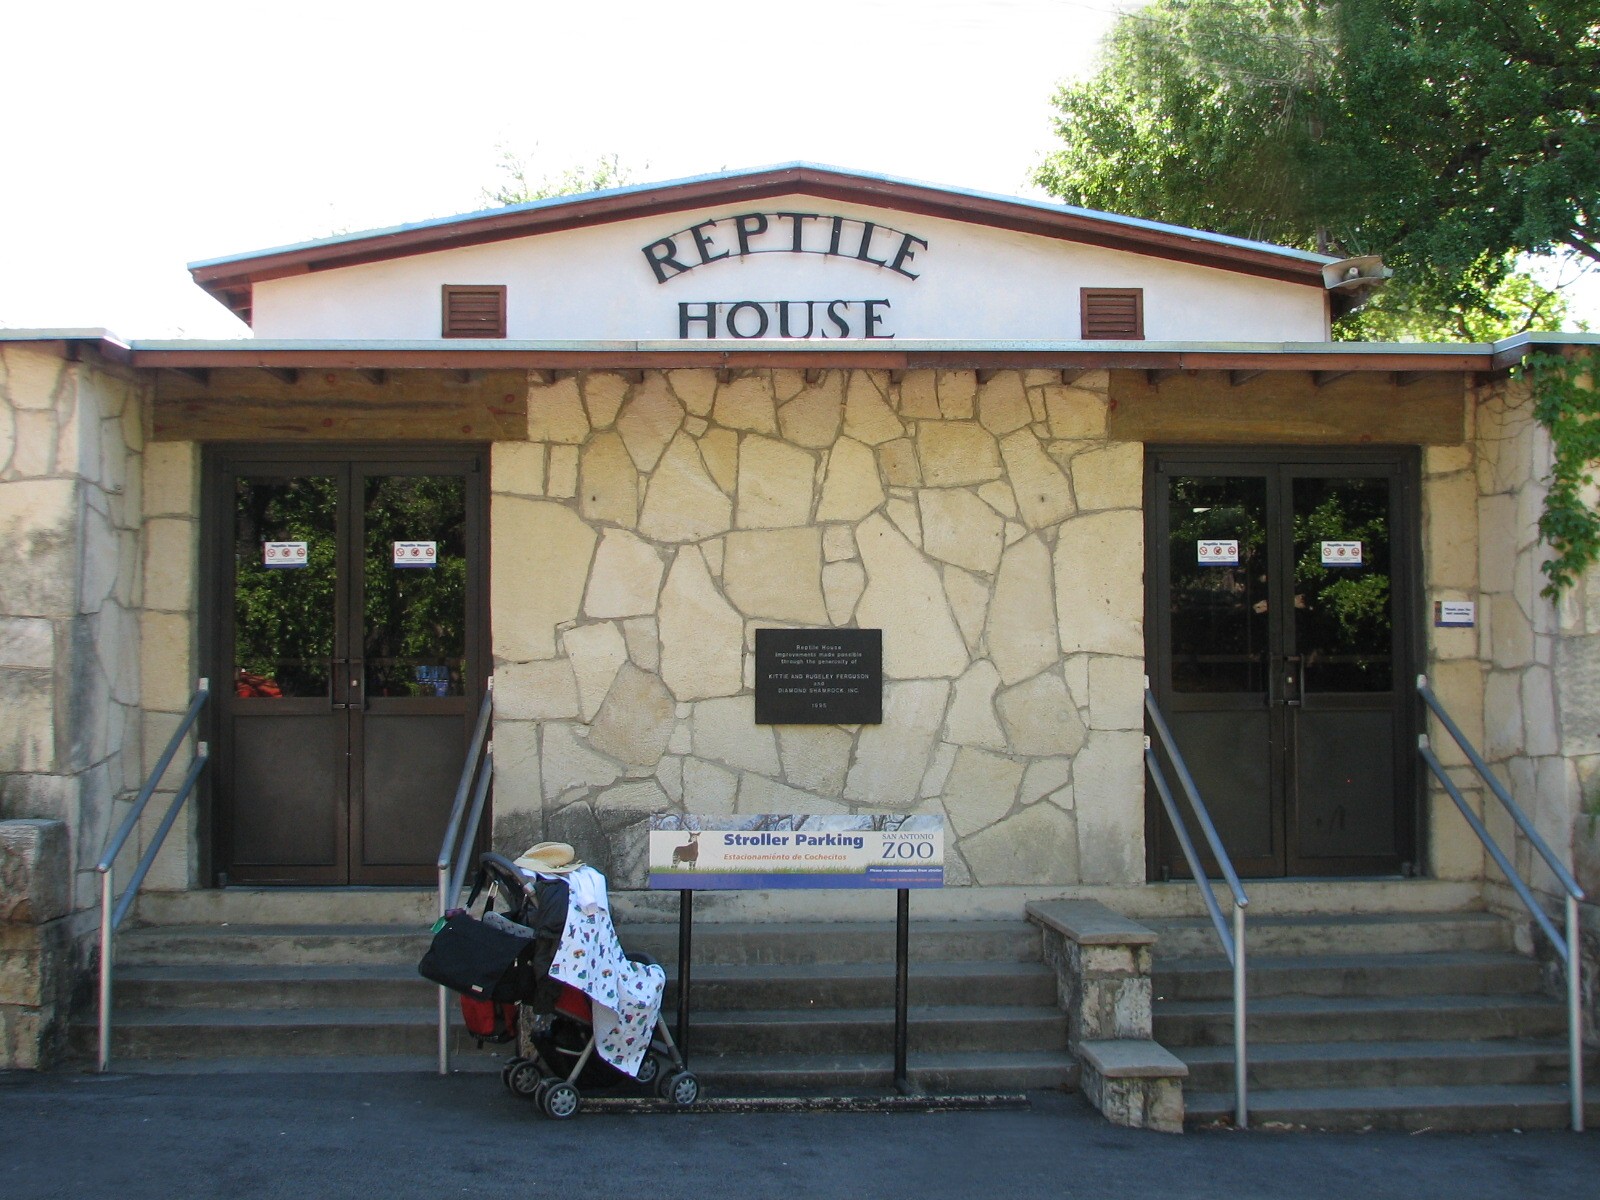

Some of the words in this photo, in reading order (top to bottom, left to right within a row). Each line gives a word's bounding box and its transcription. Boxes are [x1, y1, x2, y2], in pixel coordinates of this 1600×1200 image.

[643, 212, 928, 284] REPTILE
[678, 298, 896, 339] HOUSE
[724, 833, 789, 846] Stroller
[795, 833, 864, 849] Parking
[881, 841, 934, 859] ZOO
